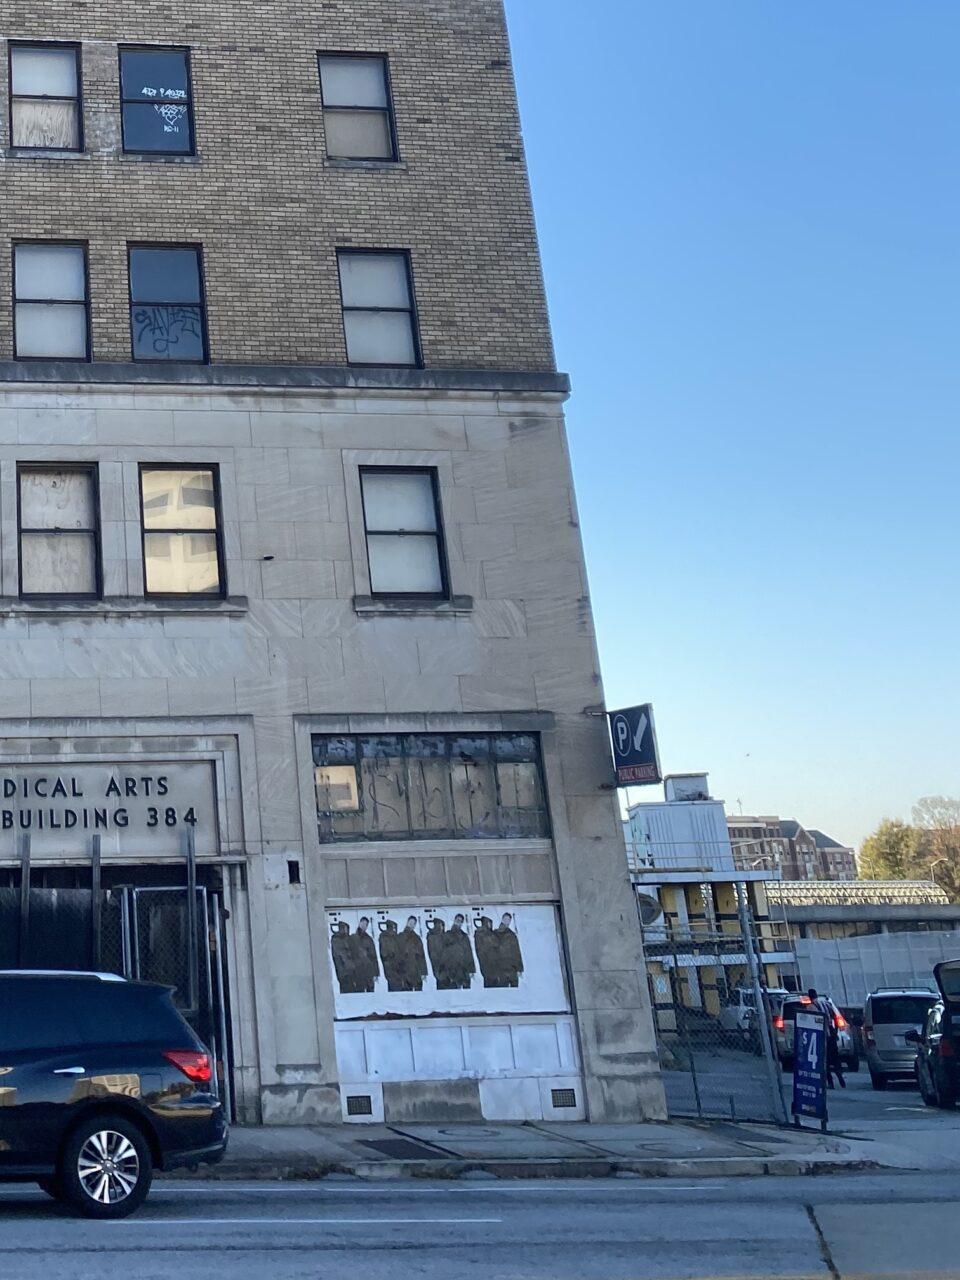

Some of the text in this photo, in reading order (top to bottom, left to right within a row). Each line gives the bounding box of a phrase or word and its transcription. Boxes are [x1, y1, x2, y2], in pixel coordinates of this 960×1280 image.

[617, 721, 628, 751] P
[105, 776, 169, 798] ARTS
[2, 807, 129, 830] BUILDING
[146, 806, 198, 828] 384
[807, 1032, 818, 1070] 4
